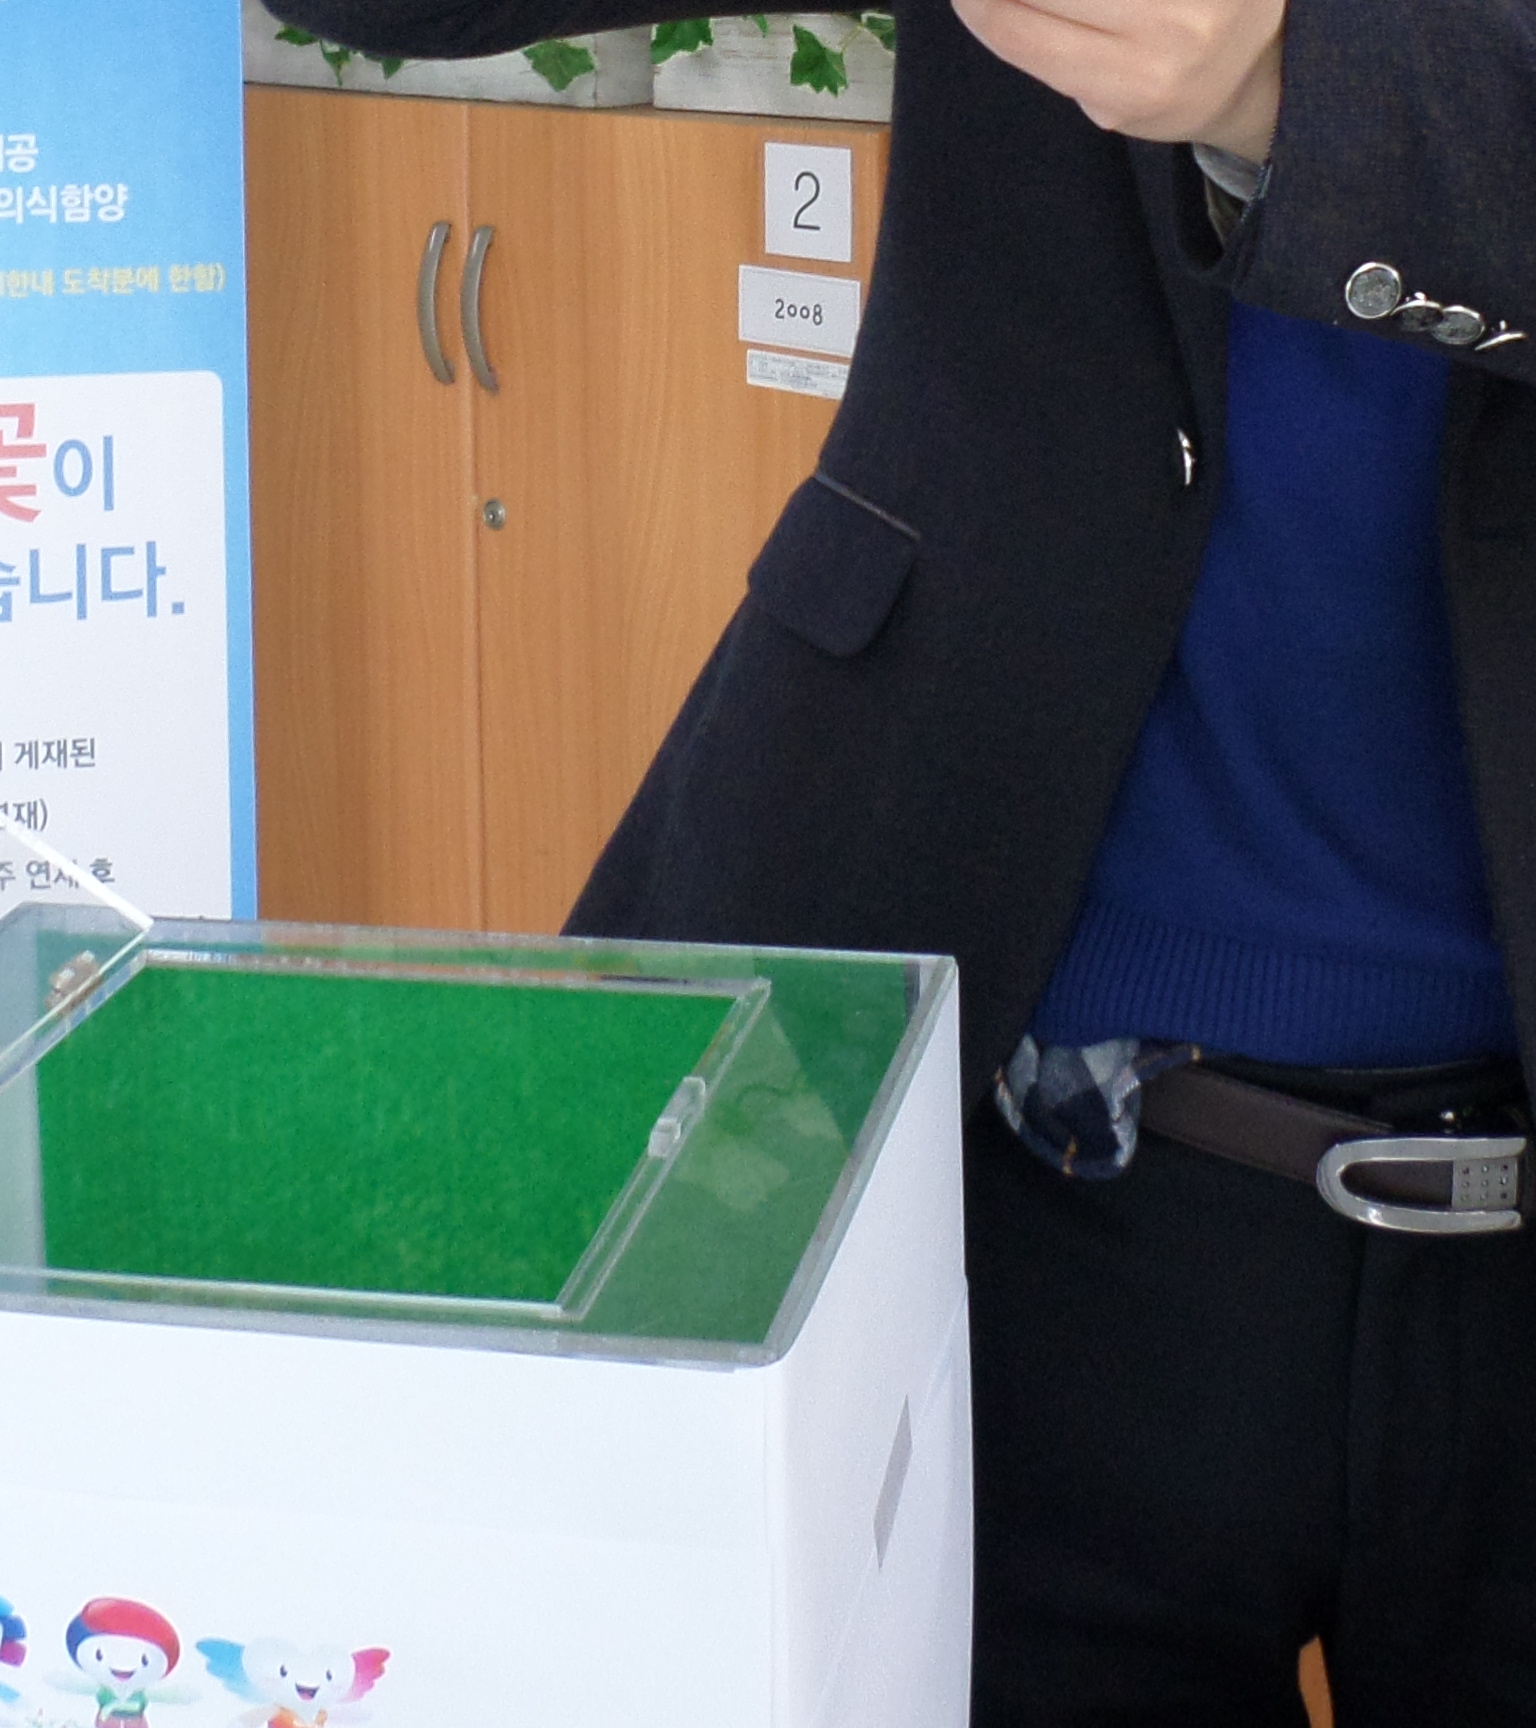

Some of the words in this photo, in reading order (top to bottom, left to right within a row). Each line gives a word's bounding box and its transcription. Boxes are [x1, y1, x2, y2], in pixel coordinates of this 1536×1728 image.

[793, 171, 821, 231] 2
[62, 265, 161, 295] 도착분에
[775, 298, 824, 326] 2008
[13, 737, 96, 771] 게재된
